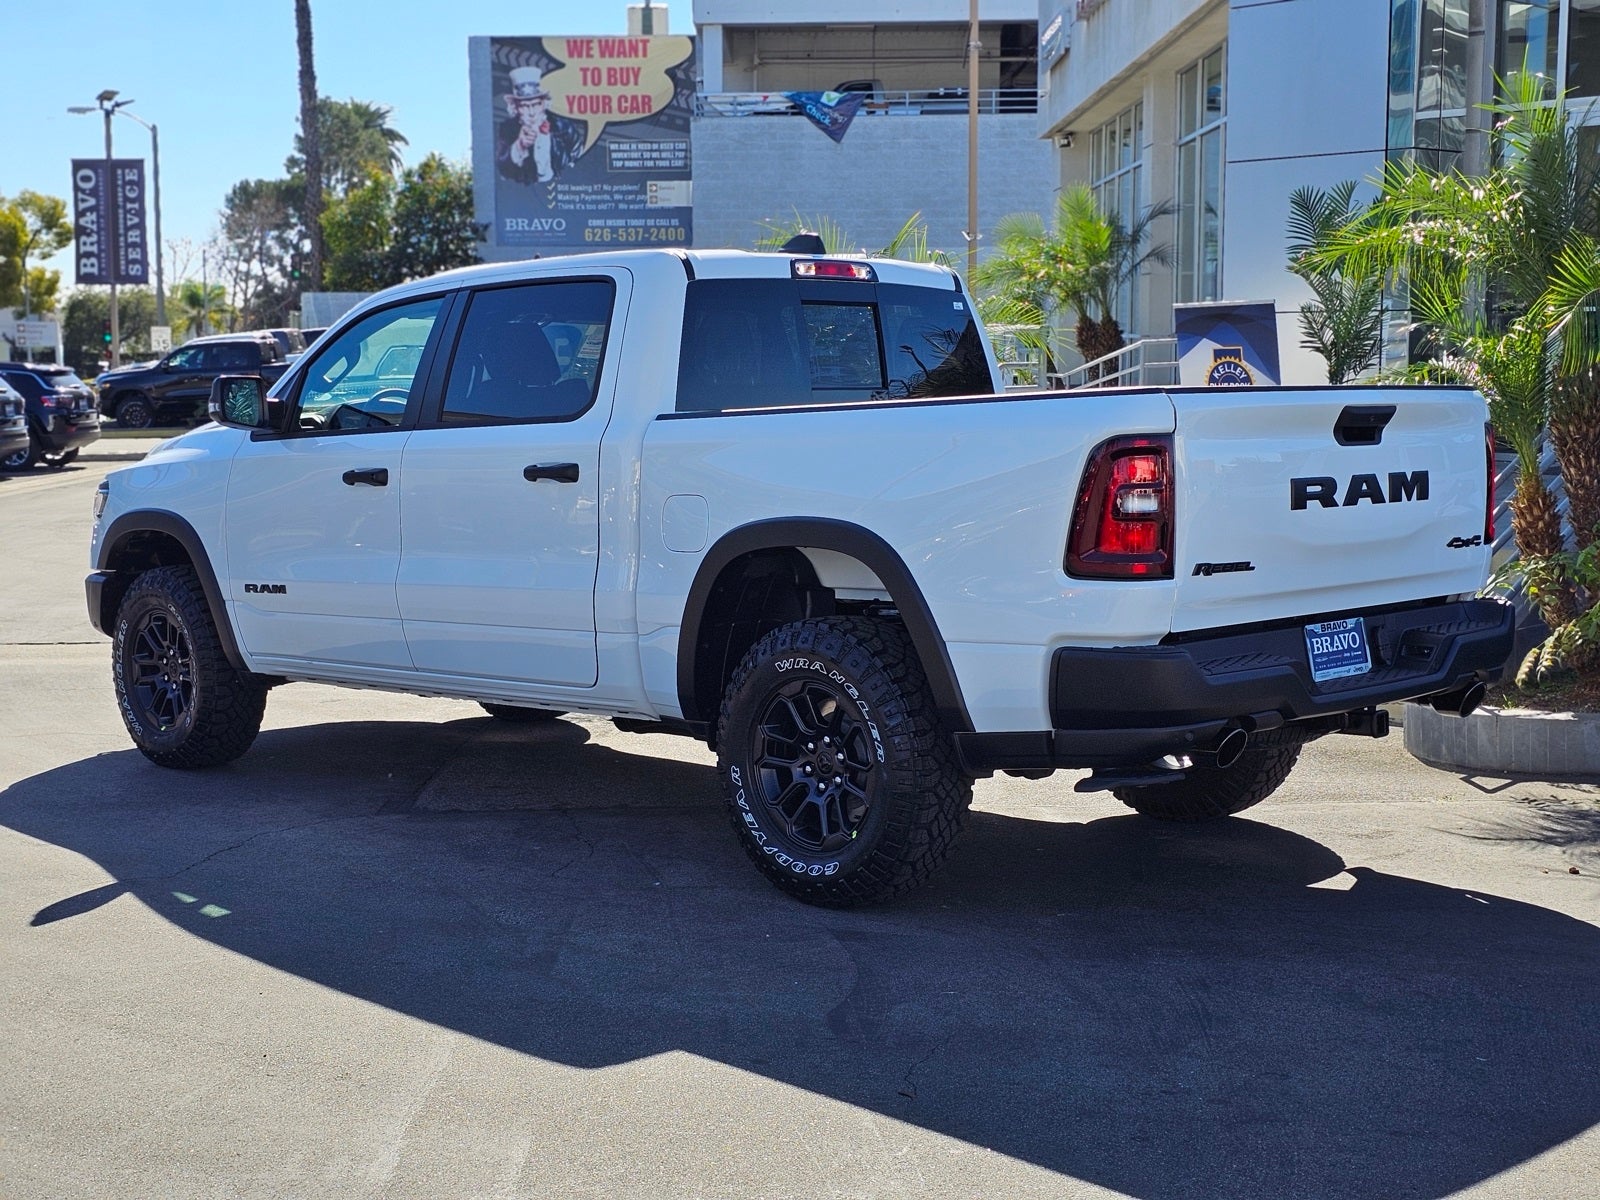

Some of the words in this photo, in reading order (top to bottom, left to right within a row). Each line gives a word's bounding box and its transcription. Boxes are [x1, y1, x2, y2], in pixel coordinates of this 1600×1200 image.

[566, 39, 594, 58] WE
[598, 39, 650, 58] WANT
[579, 67, 602, 87] TO
[606, 67, 641, 87] BUY
[565, 94, 612, 115] YOUR
[617, 94, 652, 115] CAR
[75, 168, 99, 276] BRAVO
[124, 168, 142, 276] SERVICE
[505, 218, 566, 230] BRAVO
[585, 228, 685, 242] 626-537-2400
[1212, 363, 1248, 380] KELLEY
[1290, 469, 1430, 511] RAM
[244, 584, 287, 594] RAM
[1320, 620, 1348, 632] BRAVO
[1311, 632, 1360, 654] BRAVO
[775, 658, 885, 763] WRANGLER
[731, 766, 839, 876] GOODYEAR
